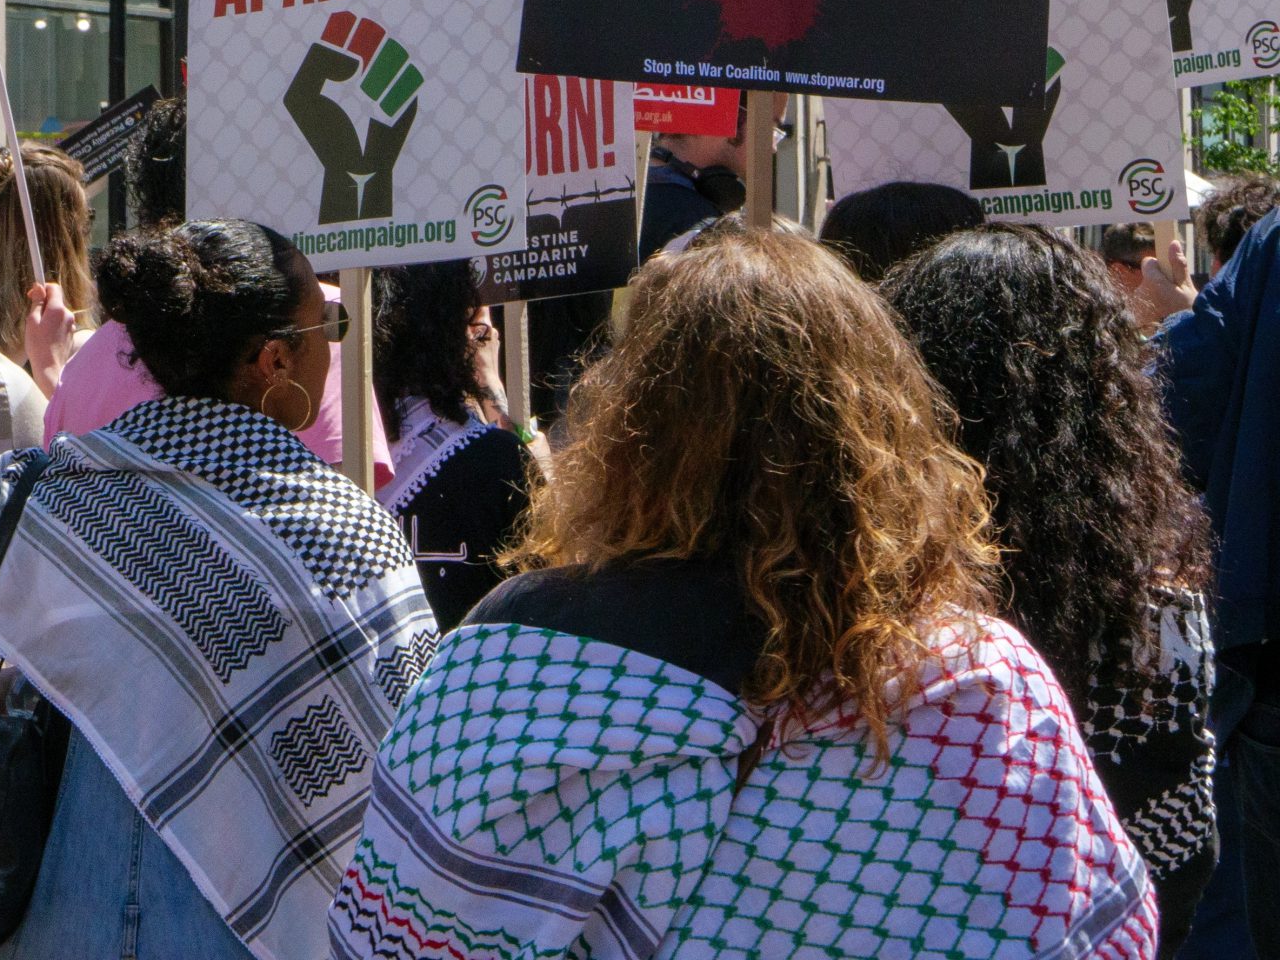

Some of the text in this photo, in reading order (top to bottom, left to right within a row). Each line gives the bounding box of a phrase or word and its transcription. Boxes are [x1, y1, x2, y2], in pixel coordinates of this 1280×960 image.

[644, 58, 885, 92] Stop the War Coalition www.stopwar.org
[492, 245, 588, 269] SOLIDARITY
[493, 262, 577, 284] CAMPAIGN
